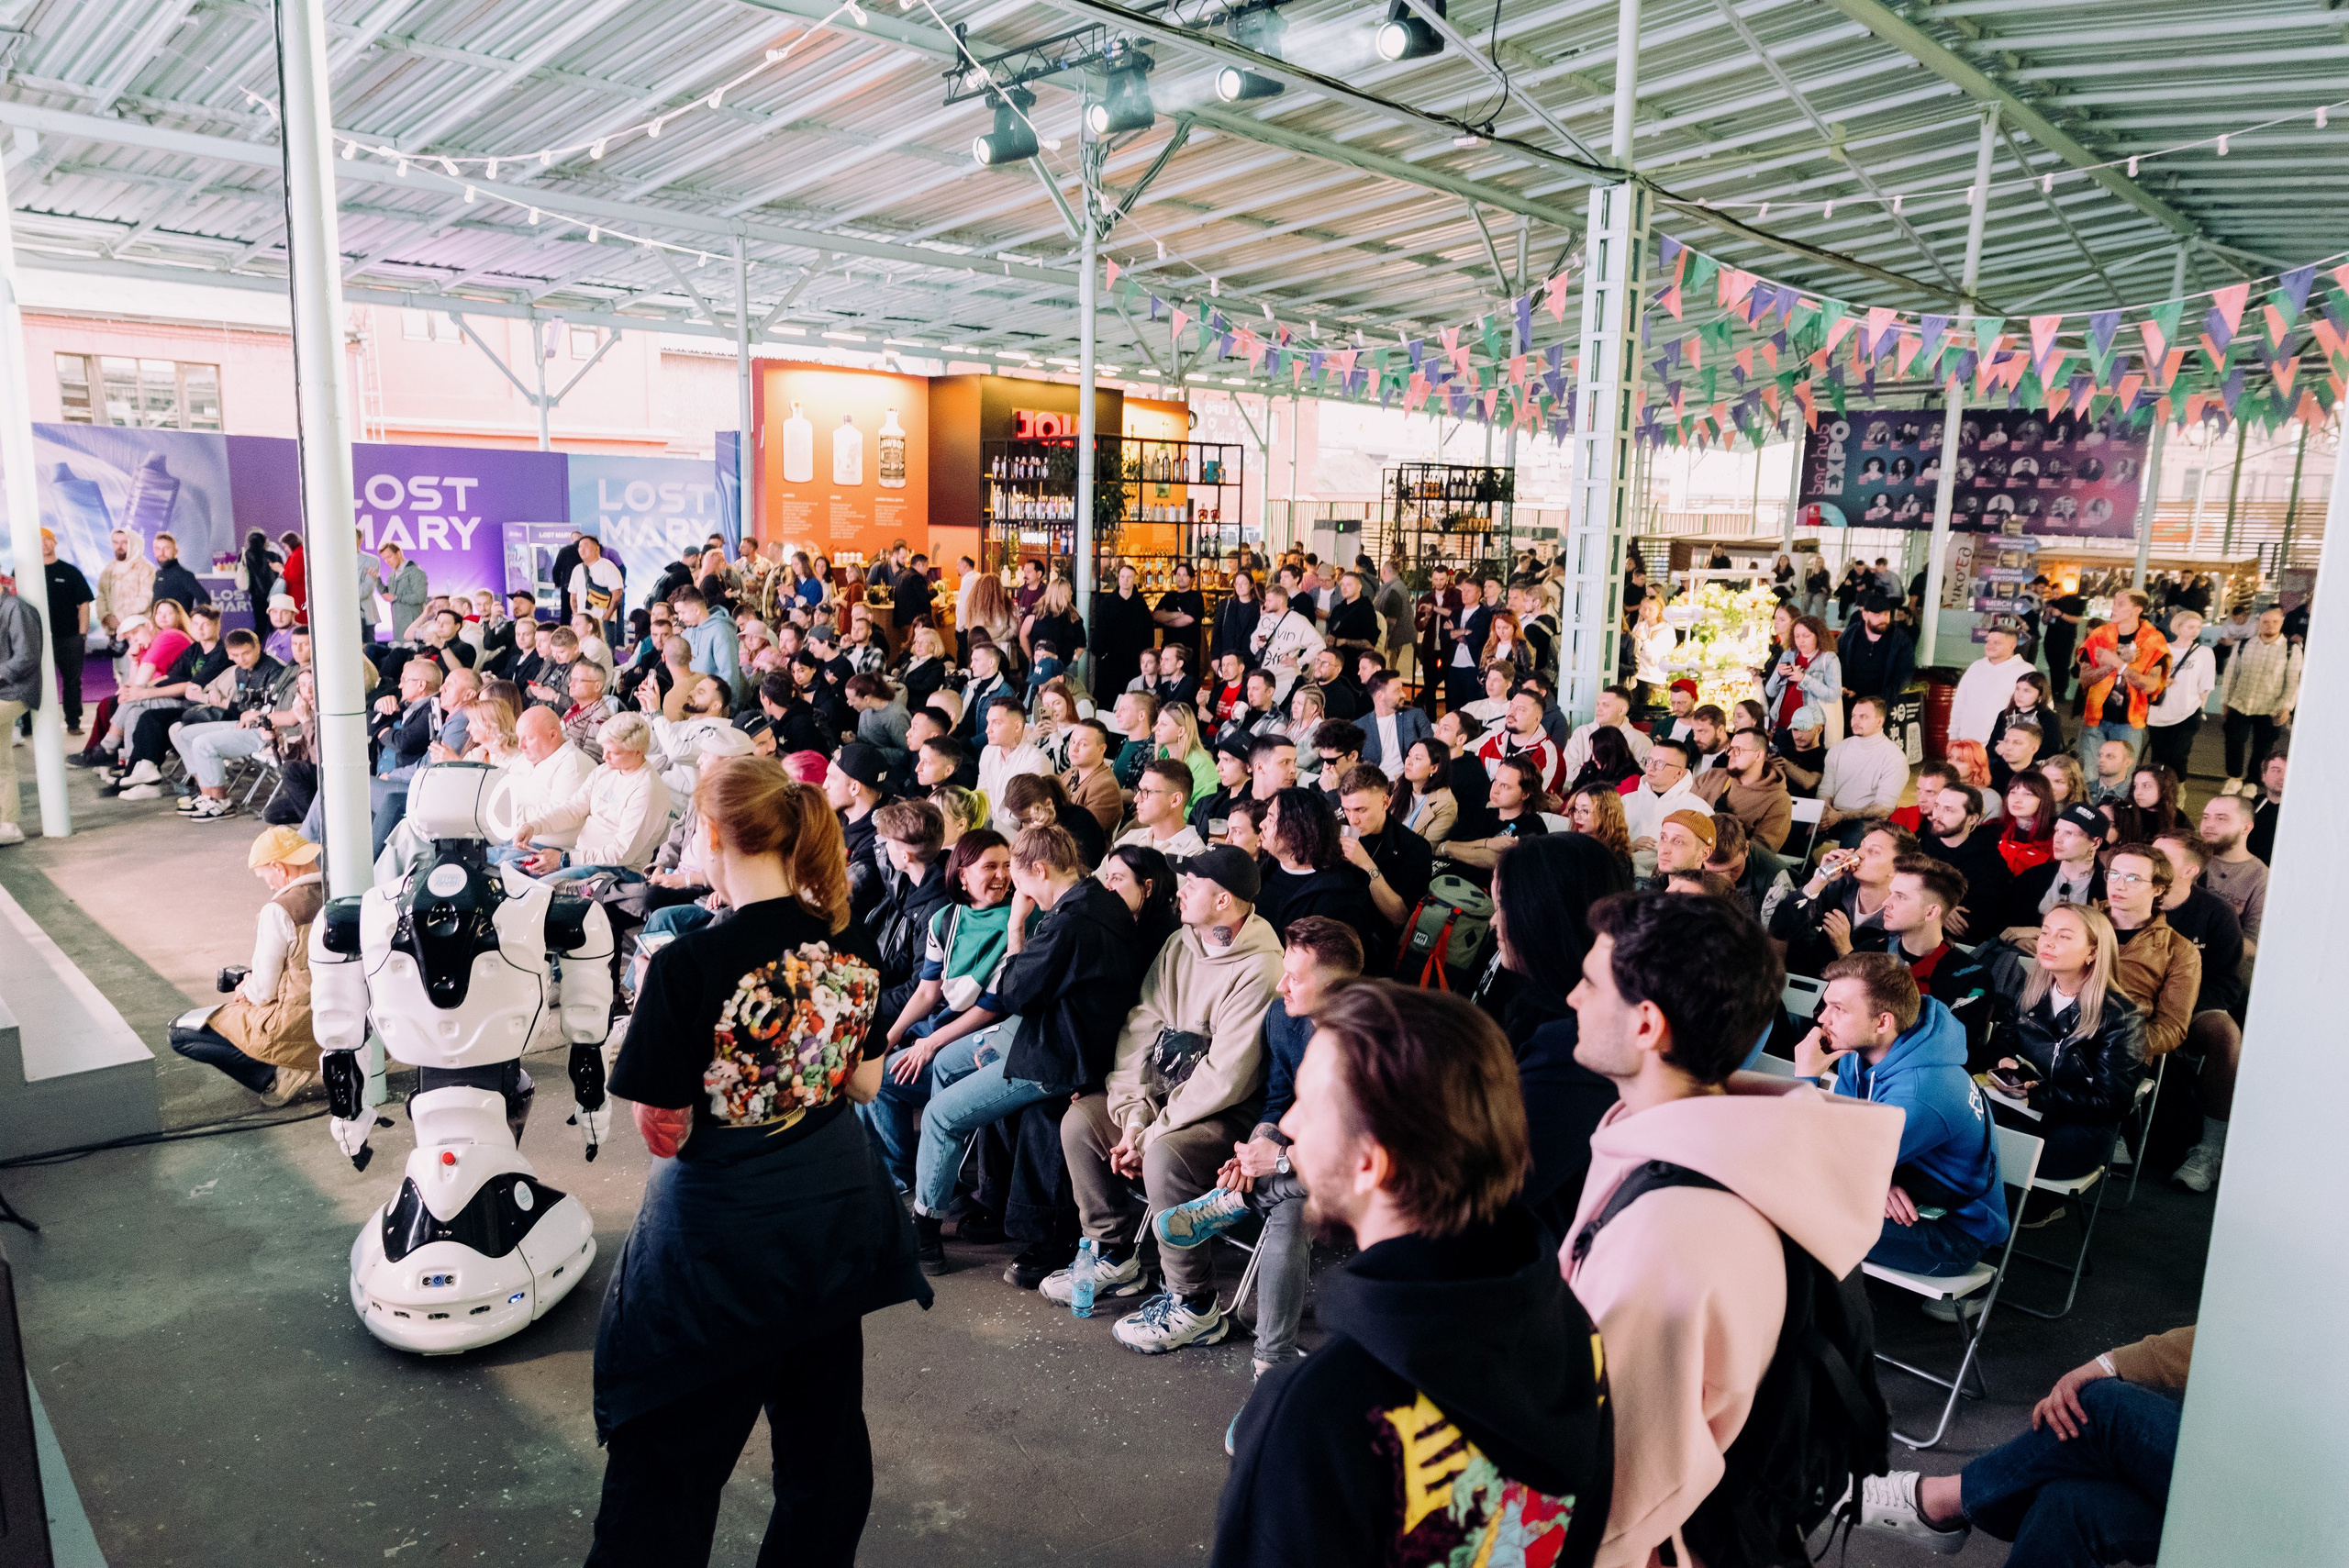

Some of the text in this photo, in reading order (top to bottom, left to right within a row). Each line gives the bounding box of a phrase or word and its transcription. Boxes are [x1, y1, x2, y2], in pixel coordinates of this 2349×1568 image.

[1824, 420, 1851, 495] EXPO
[598, 478, 716, 515] LOST
[601, 515, 716, 549] MARY
[1262, 617, 1296, 642] Cavin
